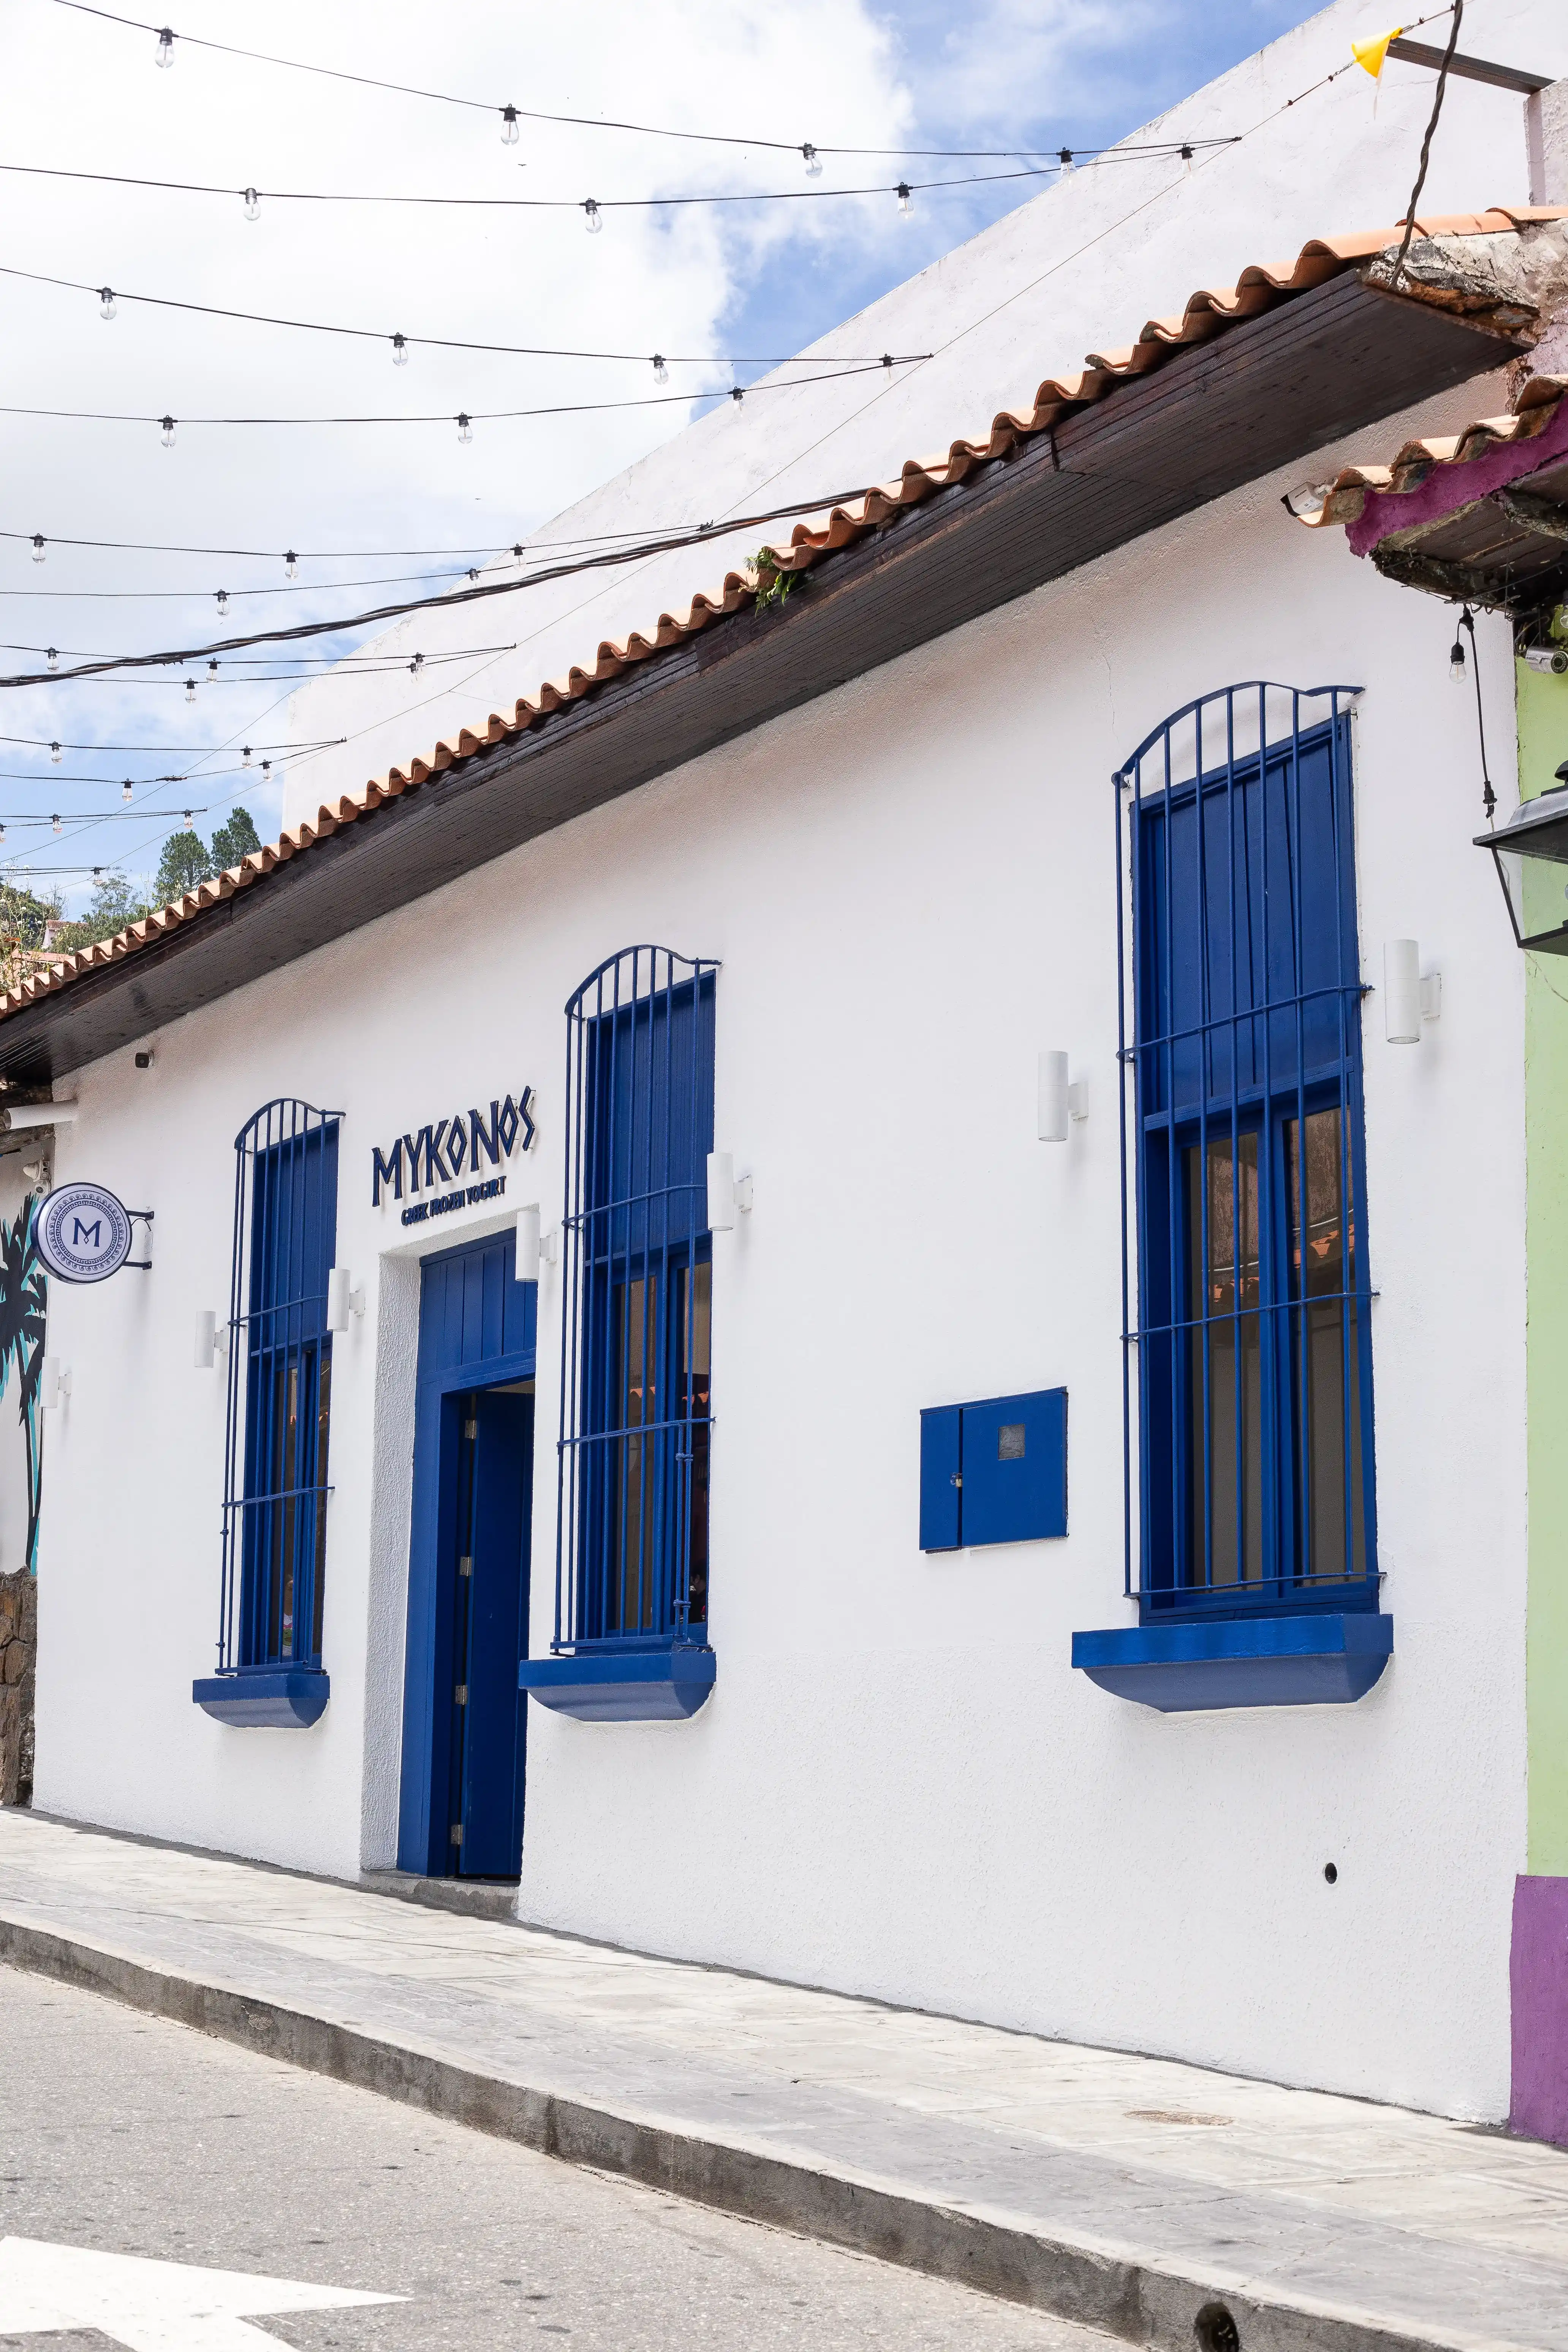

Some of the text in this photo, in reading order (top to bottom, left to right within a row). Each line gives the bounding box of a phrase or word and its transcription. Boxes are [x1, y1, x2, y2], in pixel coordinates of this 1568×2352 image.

[371, 1086, 535, 1207] MYKONOS
[401, 1175, 506, 1226] GREEK FROZEN YOGURT
[73, 1217, 102, 1247] M
